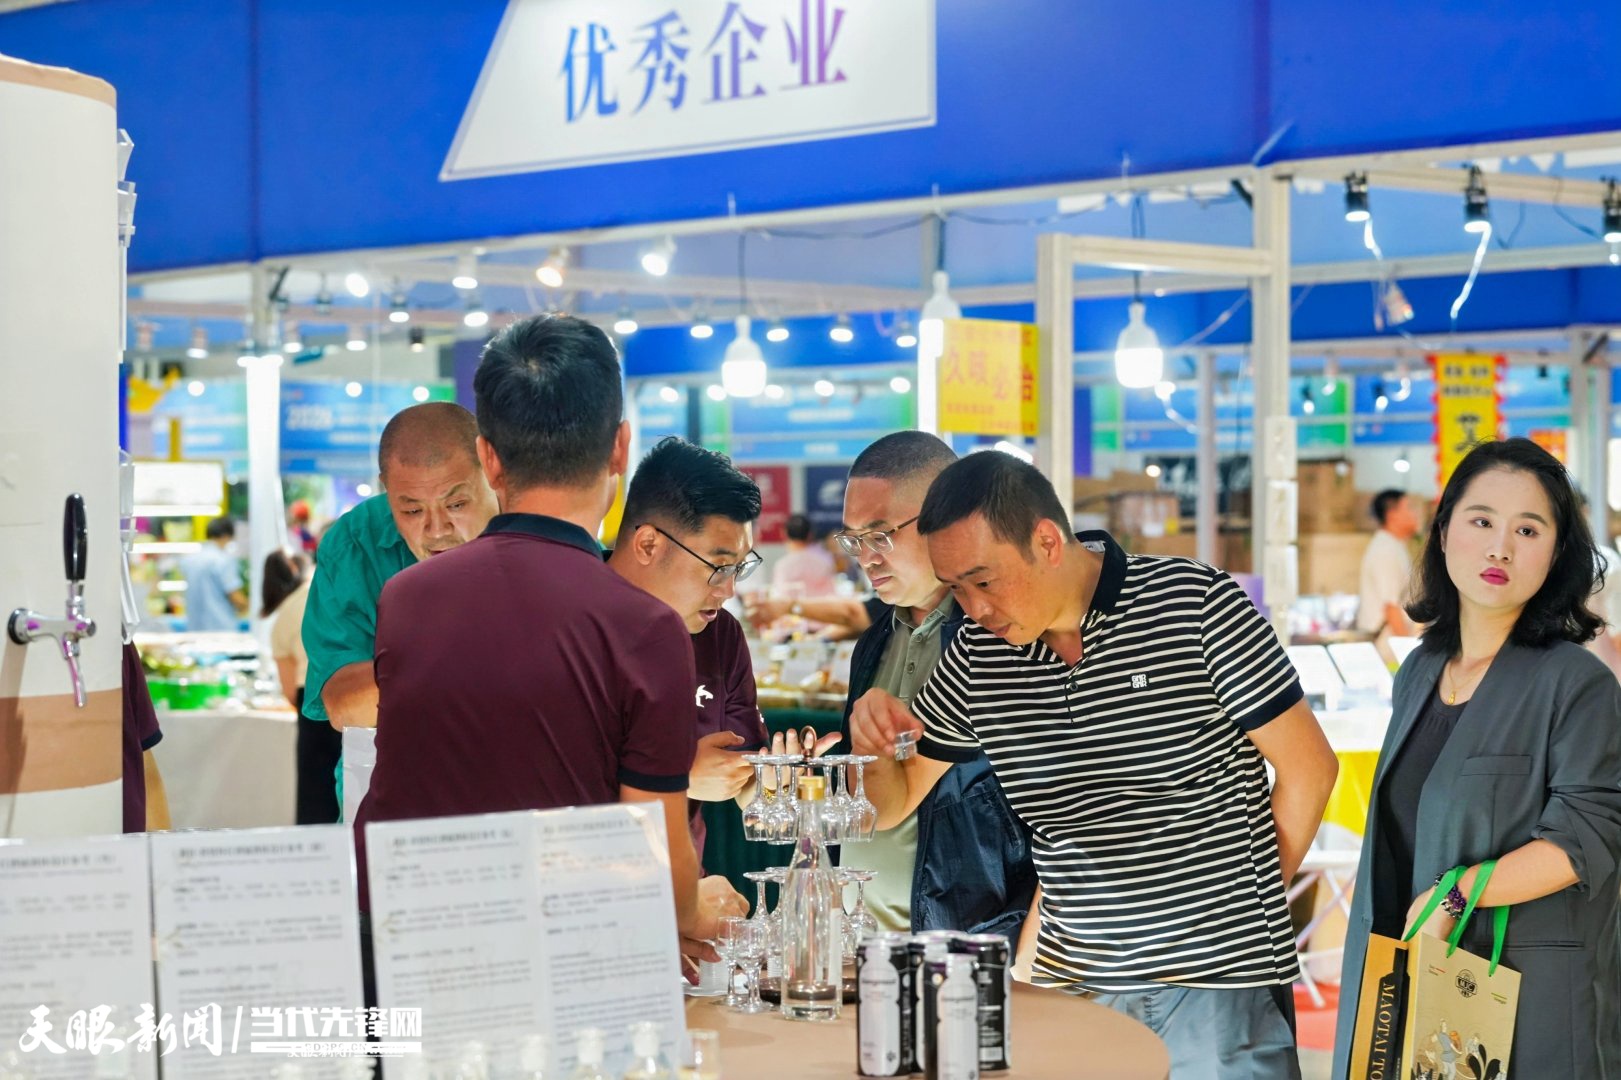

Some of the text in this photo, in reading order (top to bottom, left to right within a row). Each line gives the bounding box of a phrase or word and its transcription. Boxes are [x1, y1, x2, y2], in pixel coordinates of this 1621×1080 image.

[558, 0, 848, 123] 优秀企业
[1374, 983, 1395, 1054] MAOTAI
